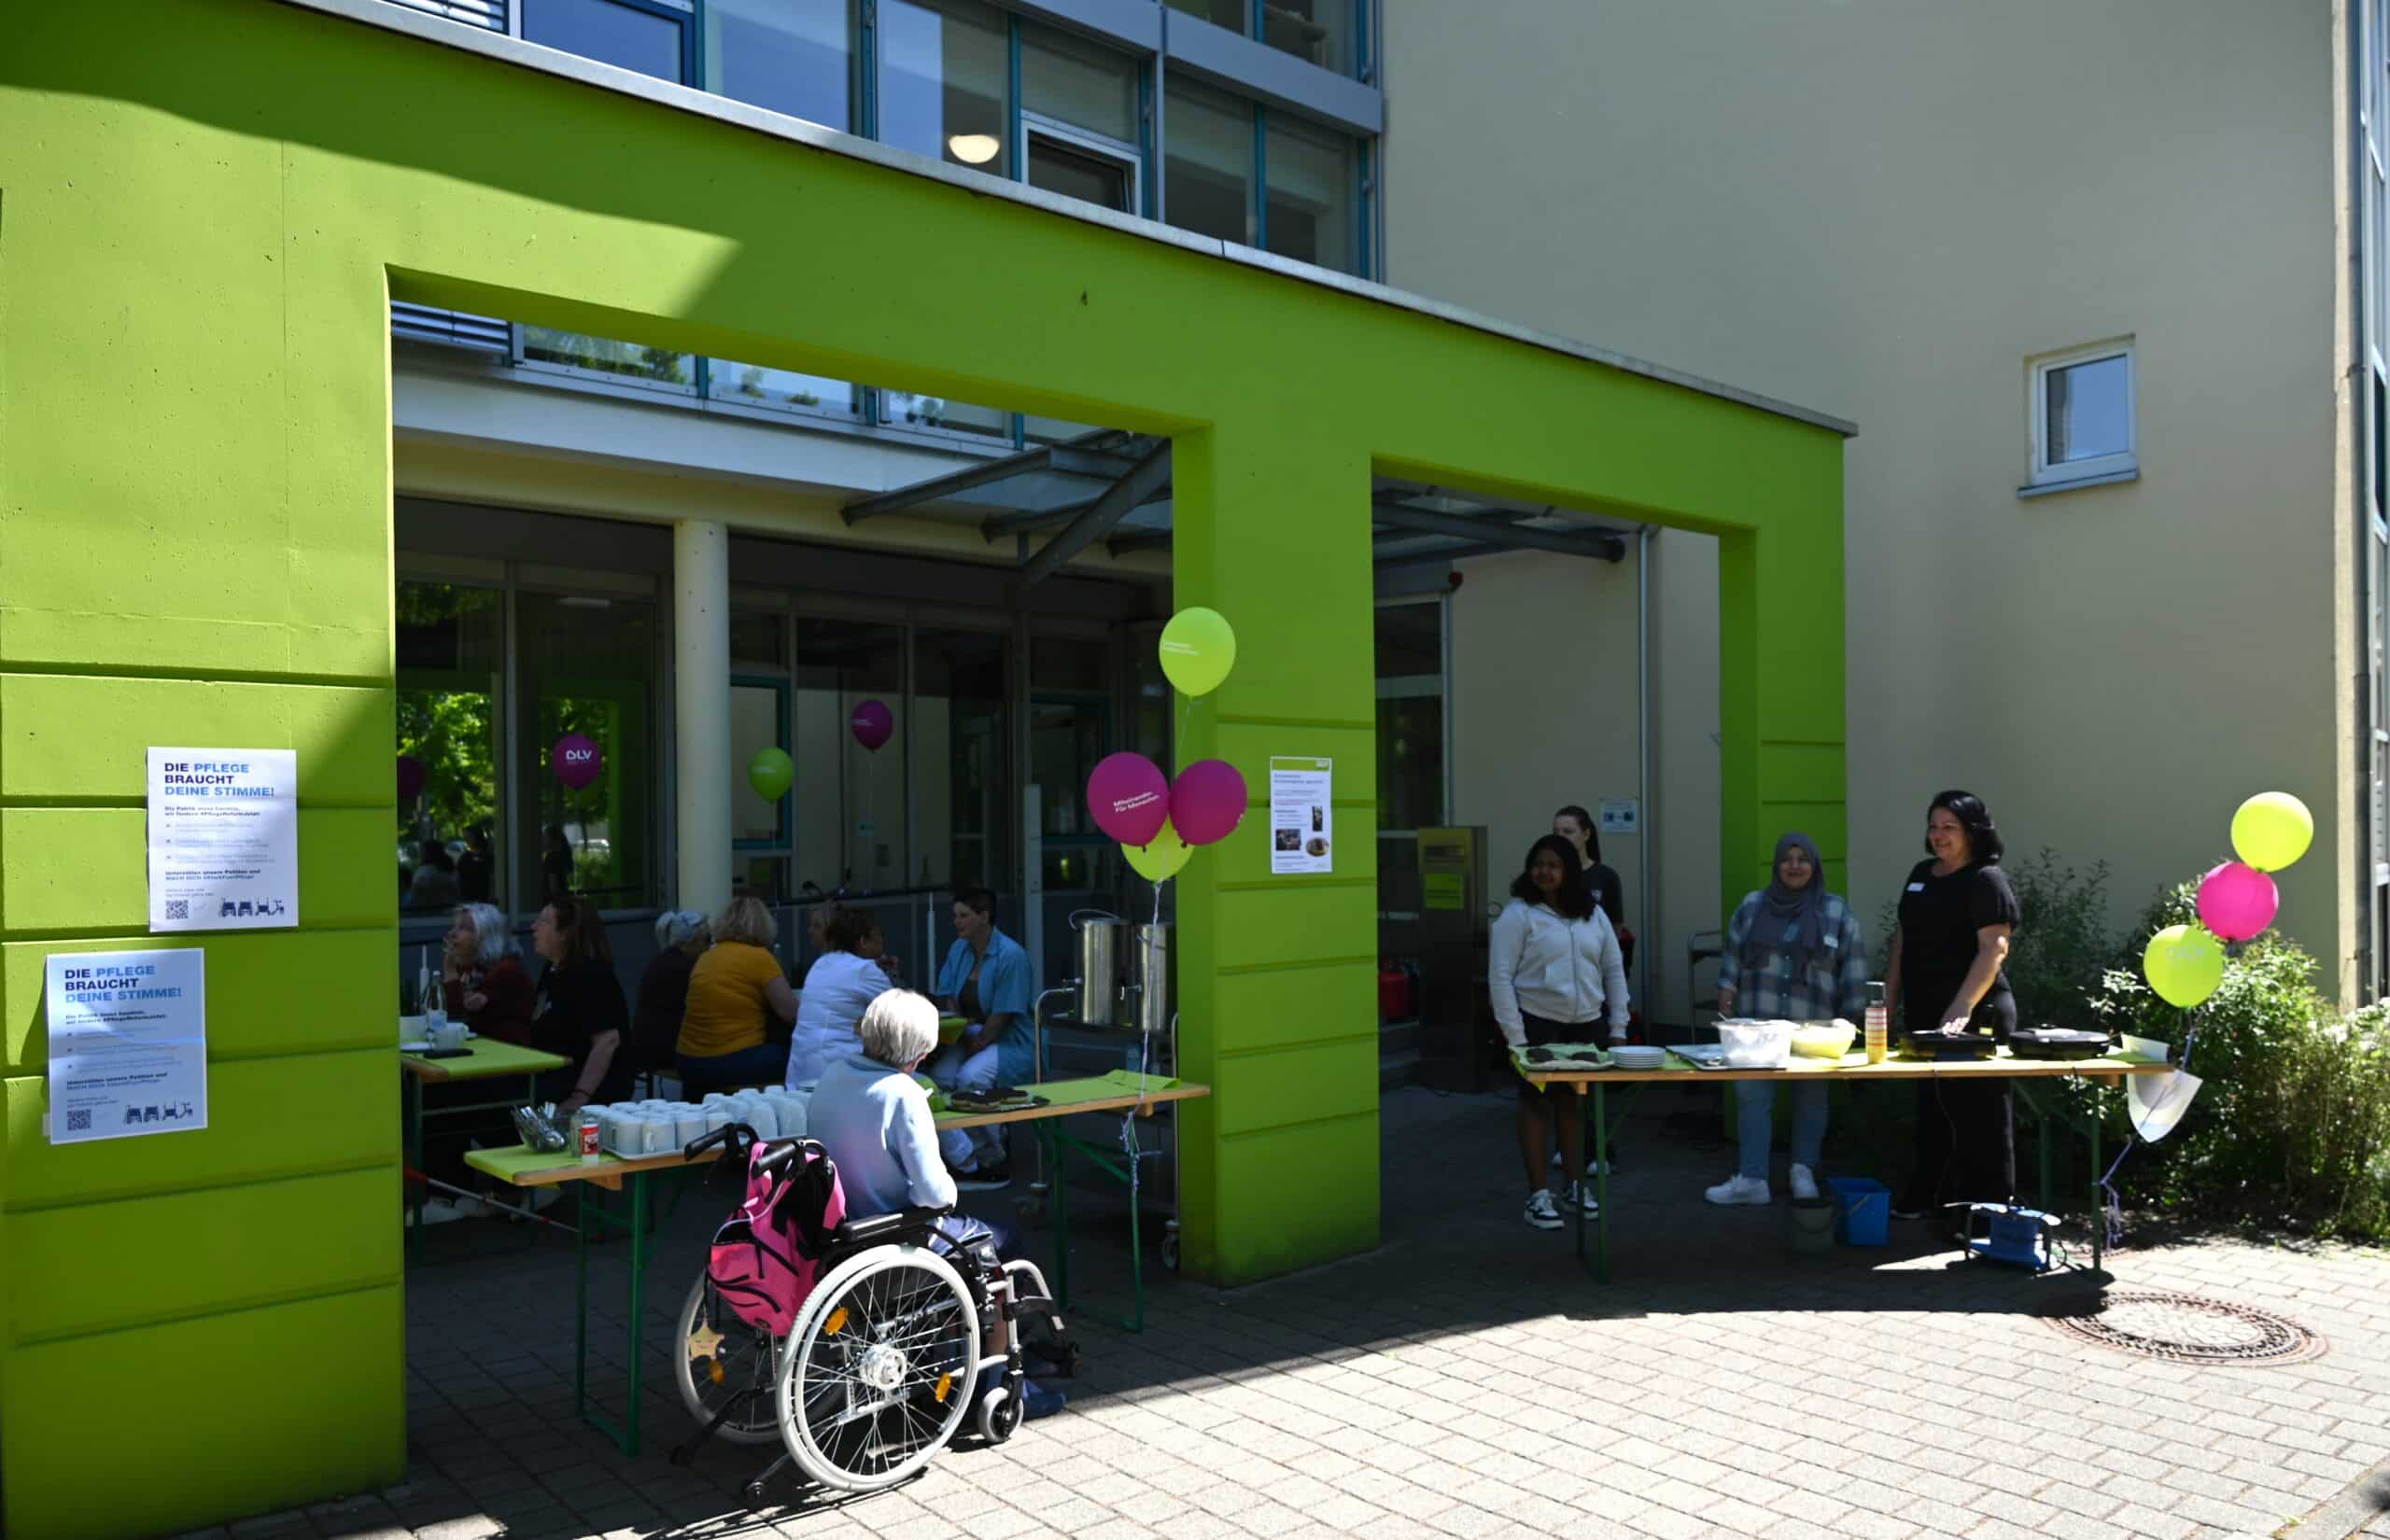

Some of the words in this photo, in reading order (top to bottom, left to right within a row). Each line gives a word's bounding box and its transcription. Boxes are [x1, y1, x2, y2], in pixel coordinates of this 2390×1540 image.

[566, 749, 592, 760] DLV
[164, 763, 190, 772] DIE
[194, 763, 249, 773] PFLEGE
[164, 775, 234, 784] BRAUCHT
[164, 786, 209, 796] DEINE
[215, 787, 274, 797] STIMME!
[64, 969, 91, 979] DIE
[96, 965, 155, 977] PFLEGE
[65, 978, 139, 991] BRAUCHT
[65, 991, 112, 1003] DEINE
[118, 987, 181, 1001] STIMME!
